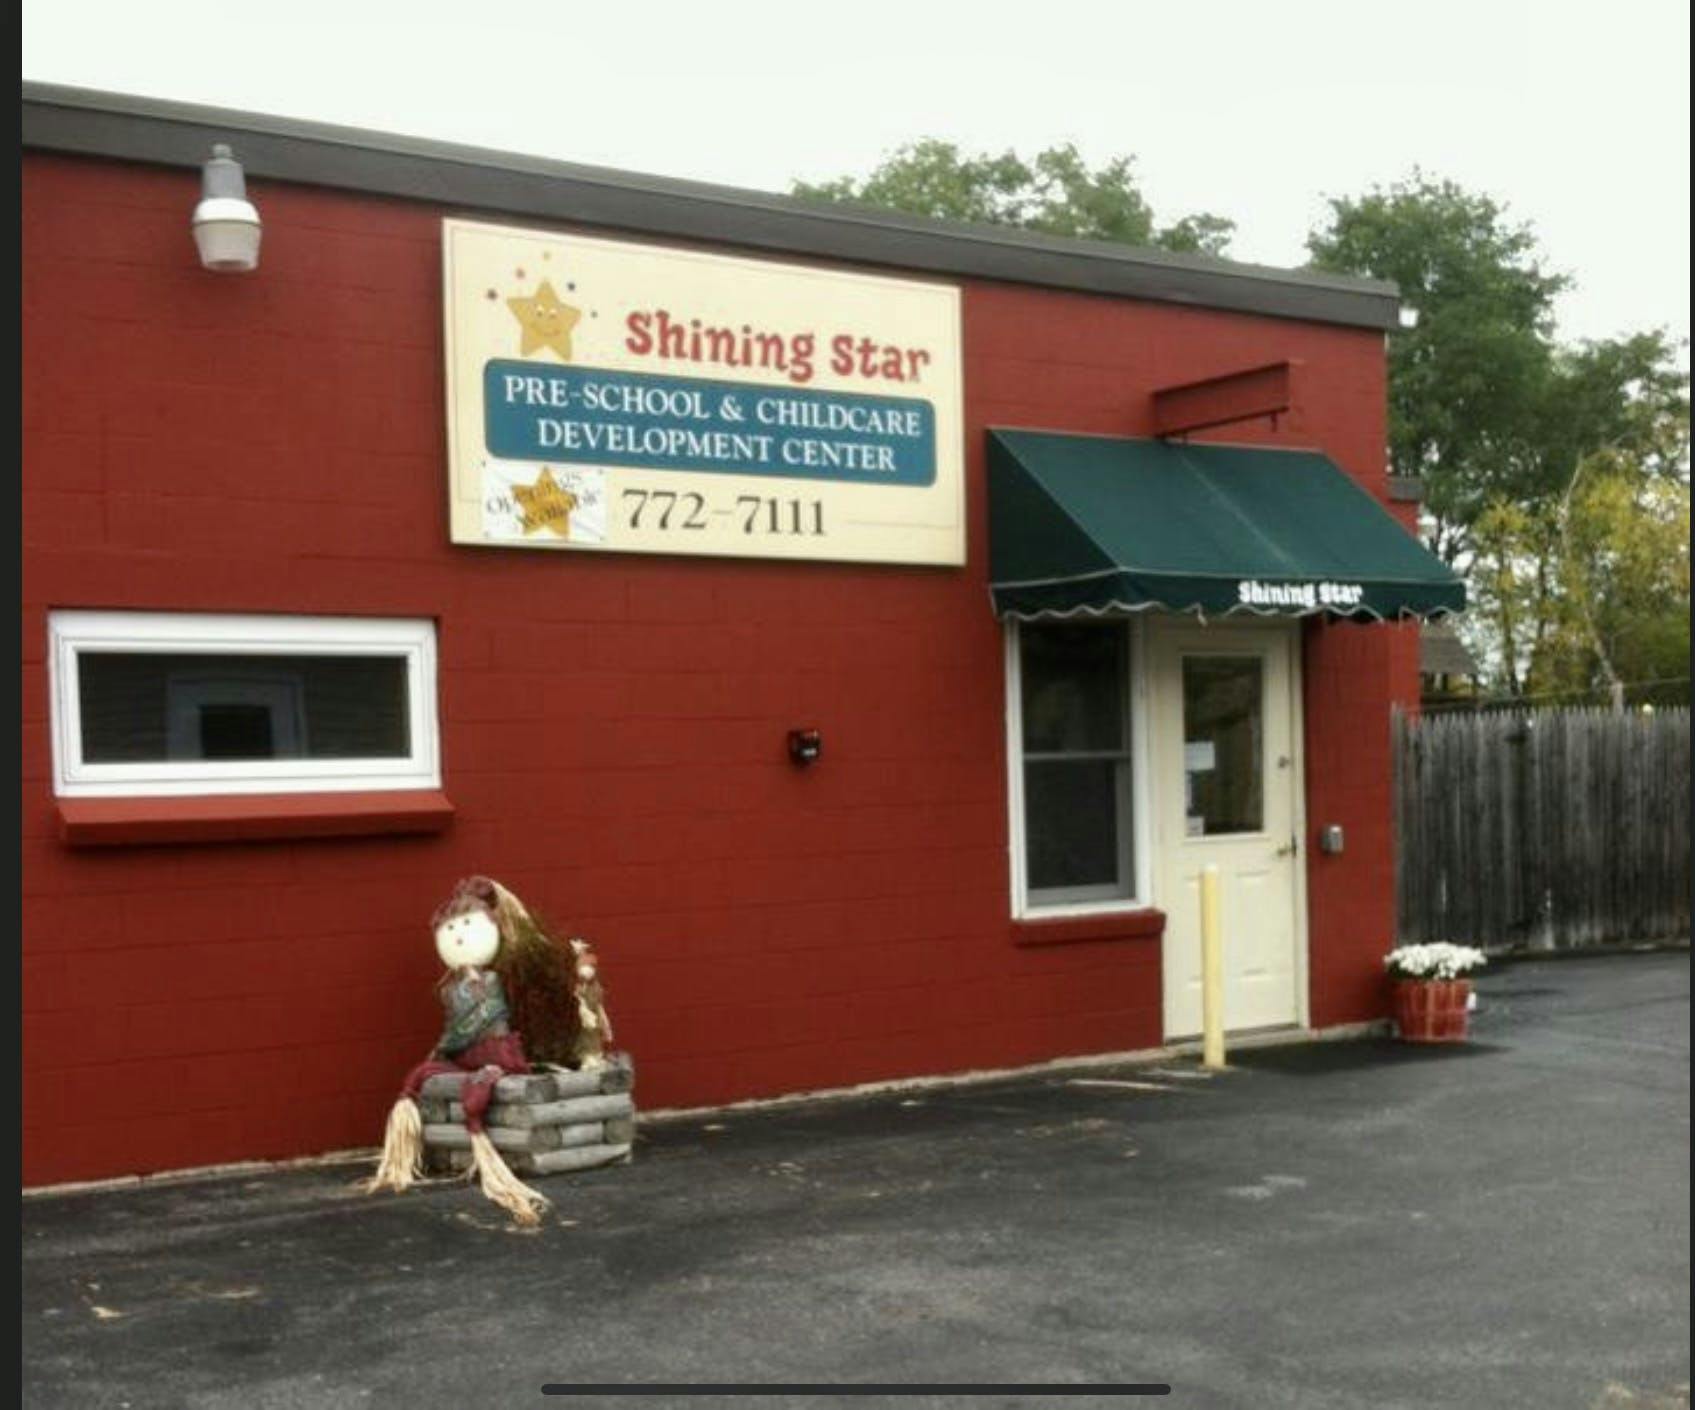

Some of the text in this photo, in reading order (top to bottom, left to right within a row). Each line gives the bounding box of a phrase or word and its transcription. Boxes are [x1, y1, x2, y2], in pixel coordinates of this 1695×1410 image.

[625, 310, 931, 383] Shining Star
[504, 375, 922, 437] PRE-SCHOOL & CHILDCARE
[537, 419, 897, 472] DEVELOPMENT CENTER
[621, 488, 826, 537] 772-7111
[1238, 580, 1363, 607] Shining Star
